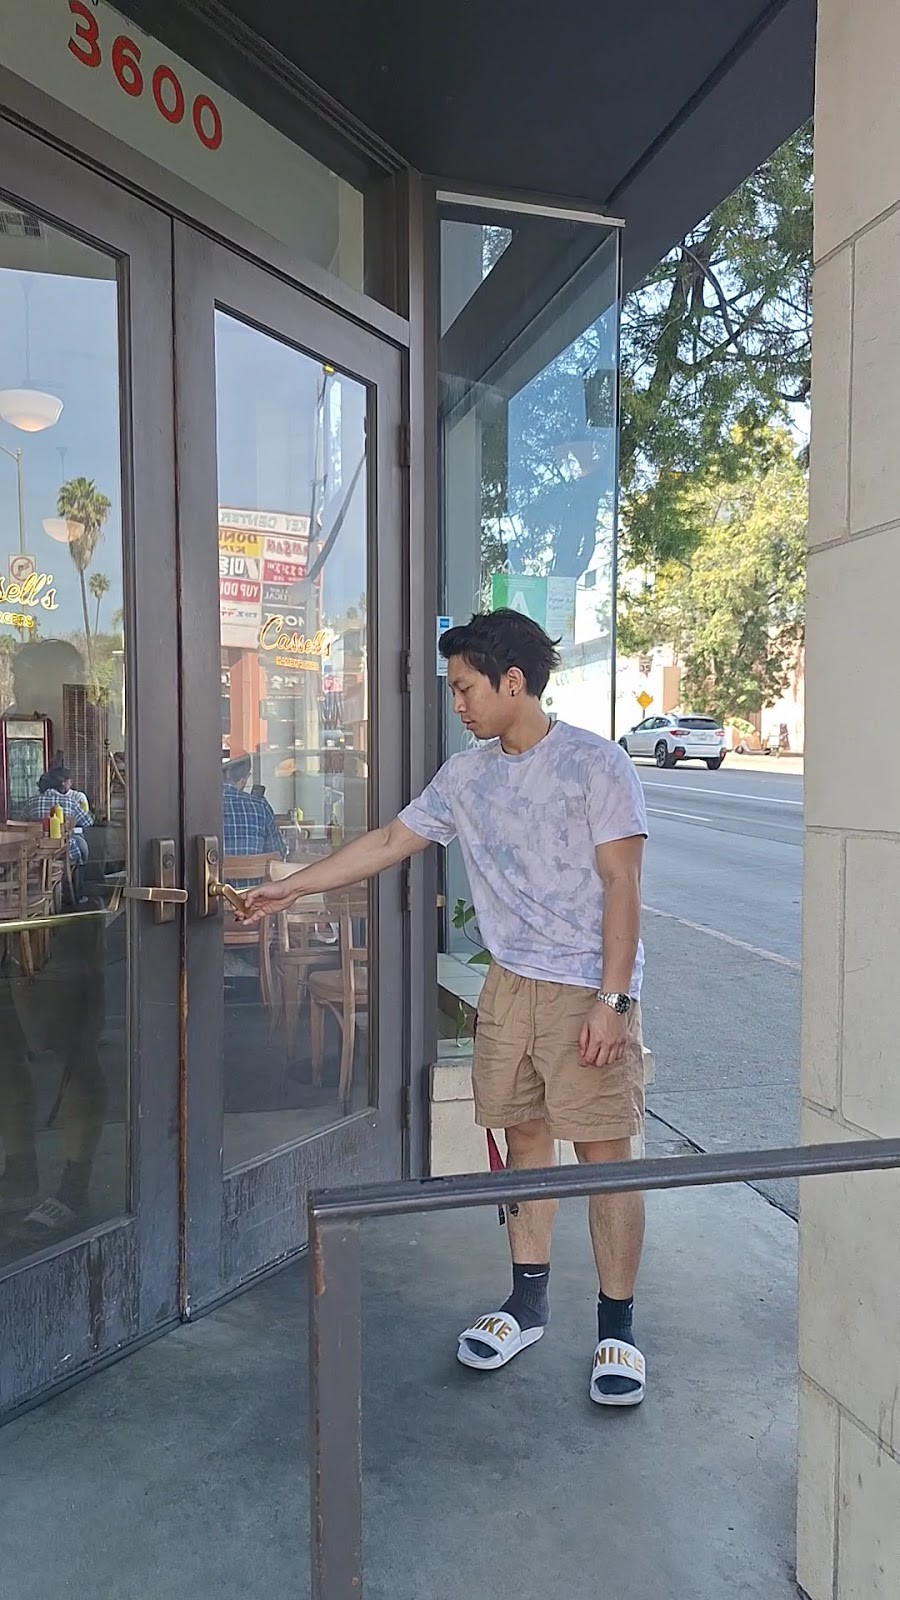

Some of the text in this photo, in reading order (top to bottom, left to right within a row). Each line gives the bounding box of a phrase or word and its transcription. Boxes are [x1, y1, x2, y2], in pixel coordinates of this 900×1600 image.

[67, 0, 223, 151] 3600
[260, 614, 333, 658] Cassell's
[594, 1346, 643, 1375] NIKE
